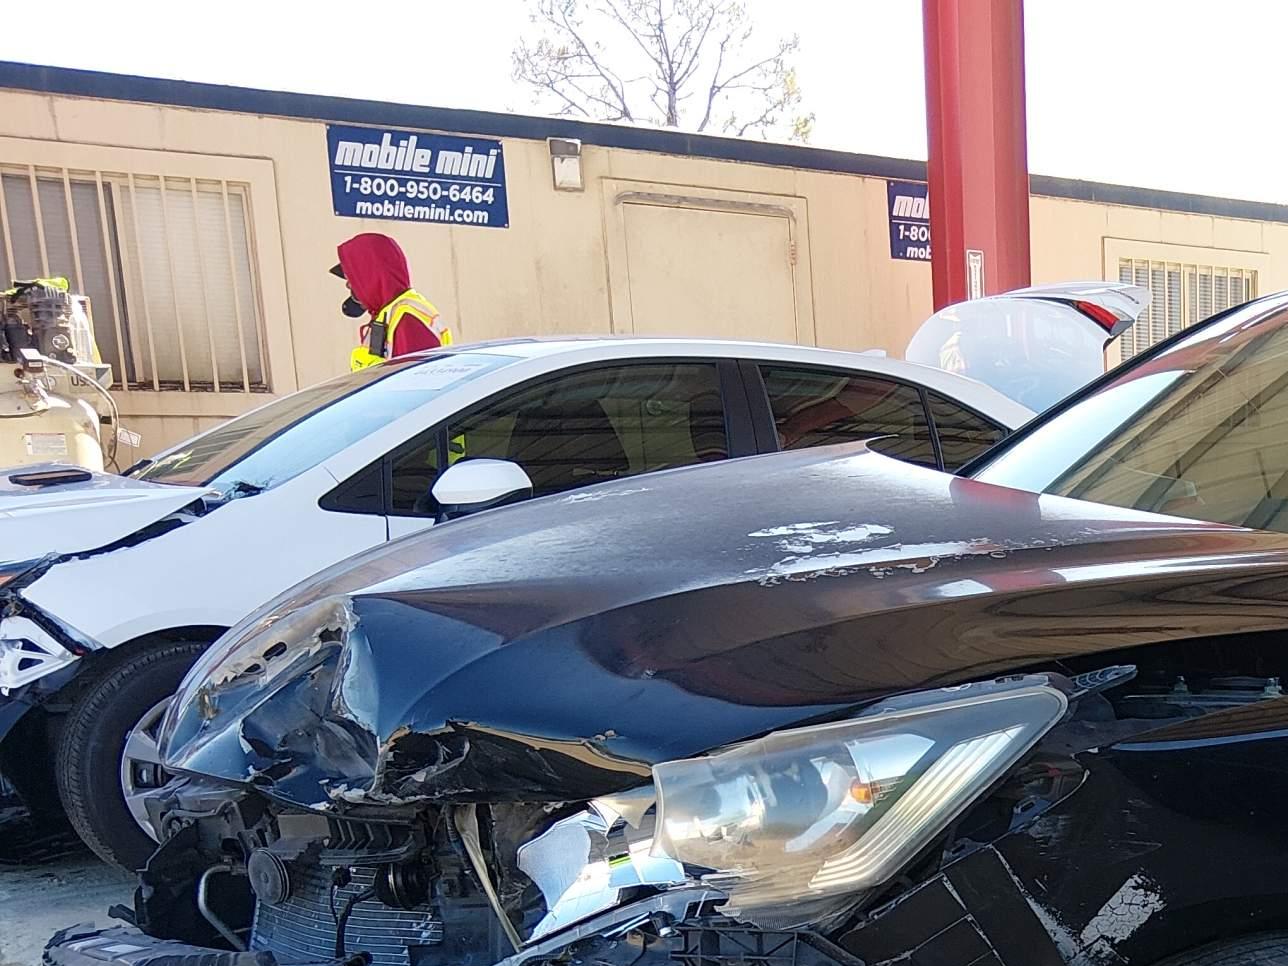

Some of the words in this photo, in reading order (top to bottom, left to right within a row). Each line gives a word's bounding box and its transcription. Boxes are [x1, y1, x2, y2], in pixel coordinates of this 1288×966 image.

[335, 133, 431, 173] mobile
[435, 146, 498, 179] mini
[343, 175, 494, 205] 1-800-950-6464
[355, 200, 489, 224] mobilemini.com
[898, 224, 931, 242] 1-80
